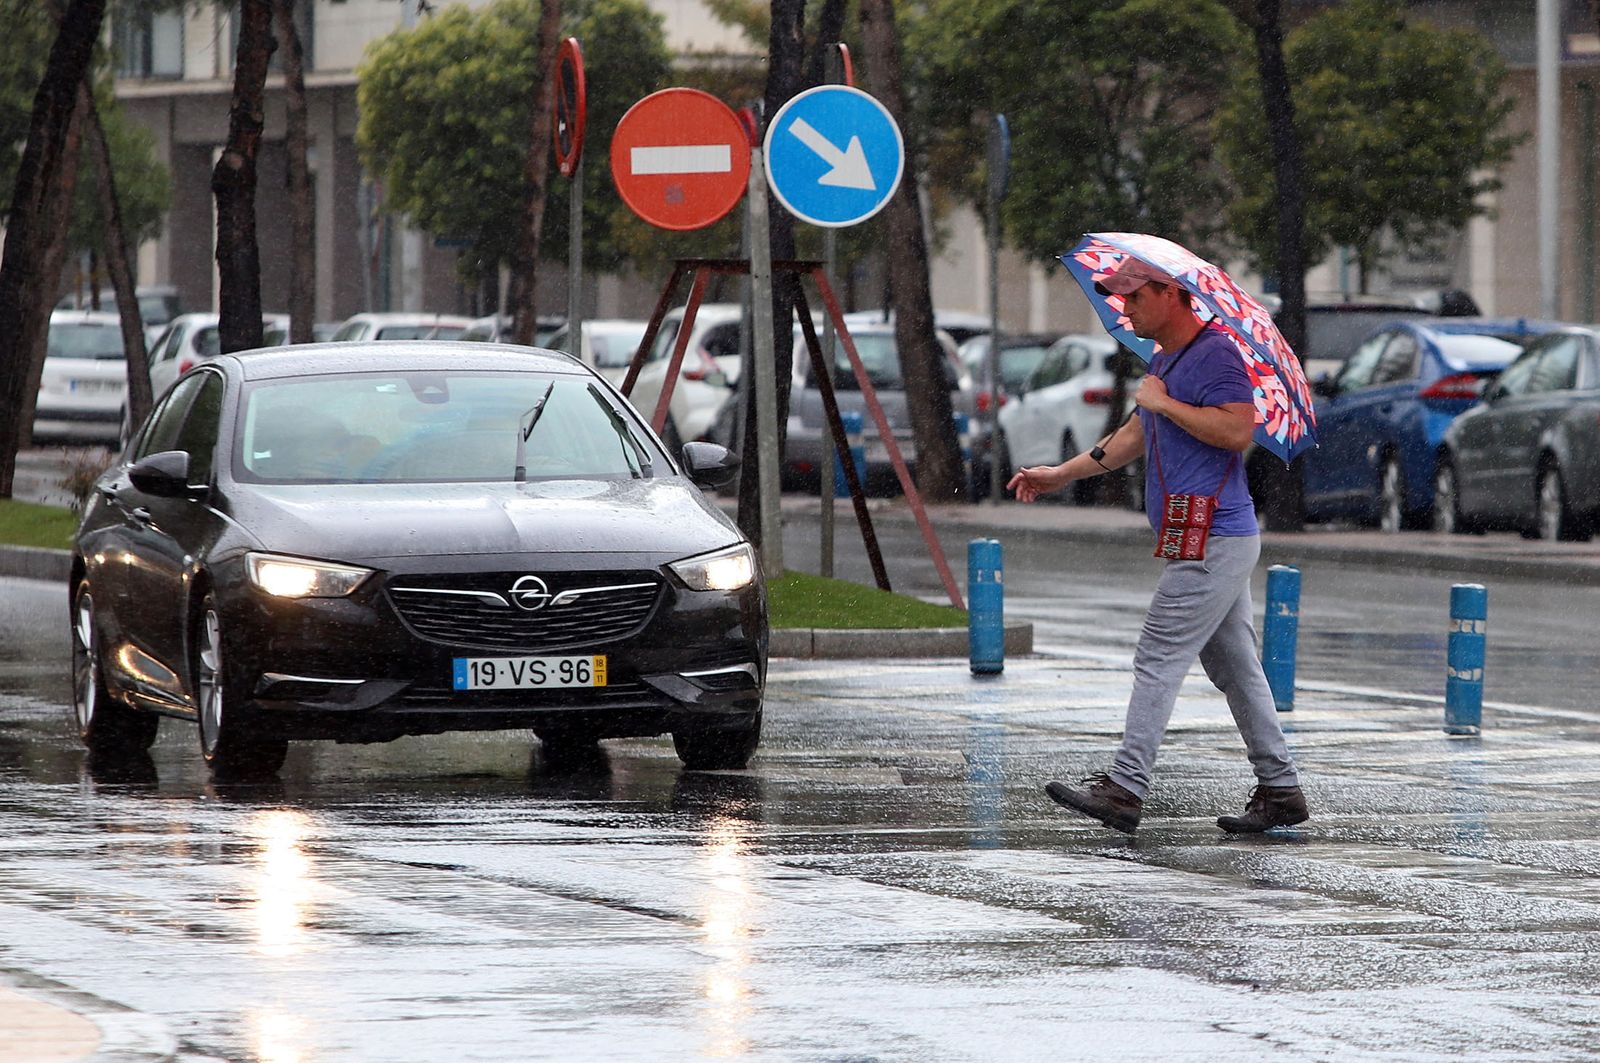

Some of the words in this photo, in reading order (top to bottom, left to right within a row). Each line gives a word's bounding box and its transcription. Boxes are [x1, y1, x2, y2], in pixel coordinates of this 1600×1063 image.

[595, 658, 604, 668] 18
[456, 676, 465, 685] P
[596, 674, 603, 683] 11
